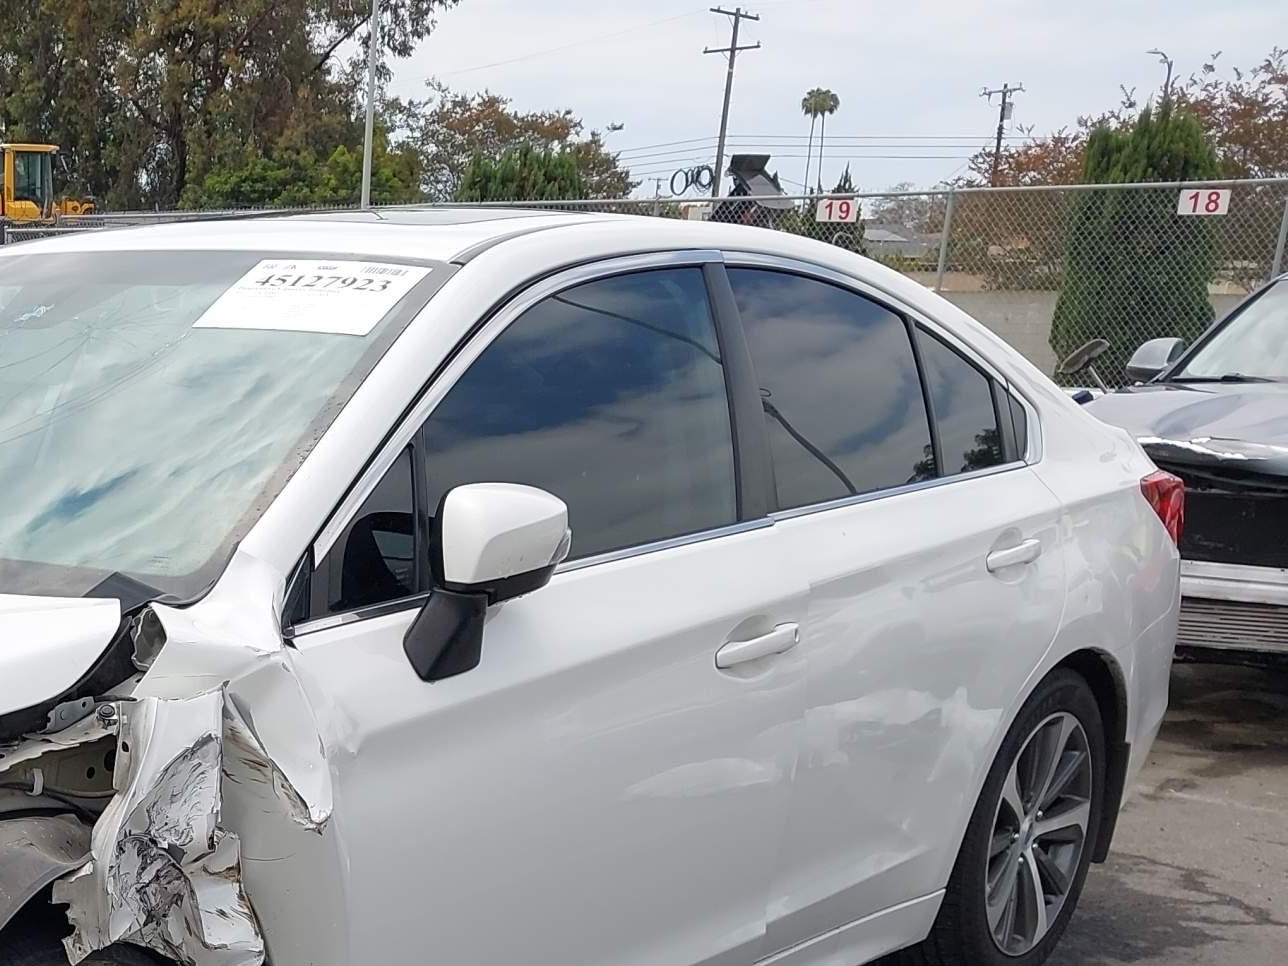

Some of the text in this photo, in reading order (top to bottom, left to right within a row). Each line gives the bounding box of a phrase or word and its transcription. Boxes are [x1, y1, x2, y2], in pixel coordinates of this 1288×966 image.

[825, 201, 851, 220] 19
[1189, 191, 1221, 213] 18
[255, 273, 393, 292] 45127923
